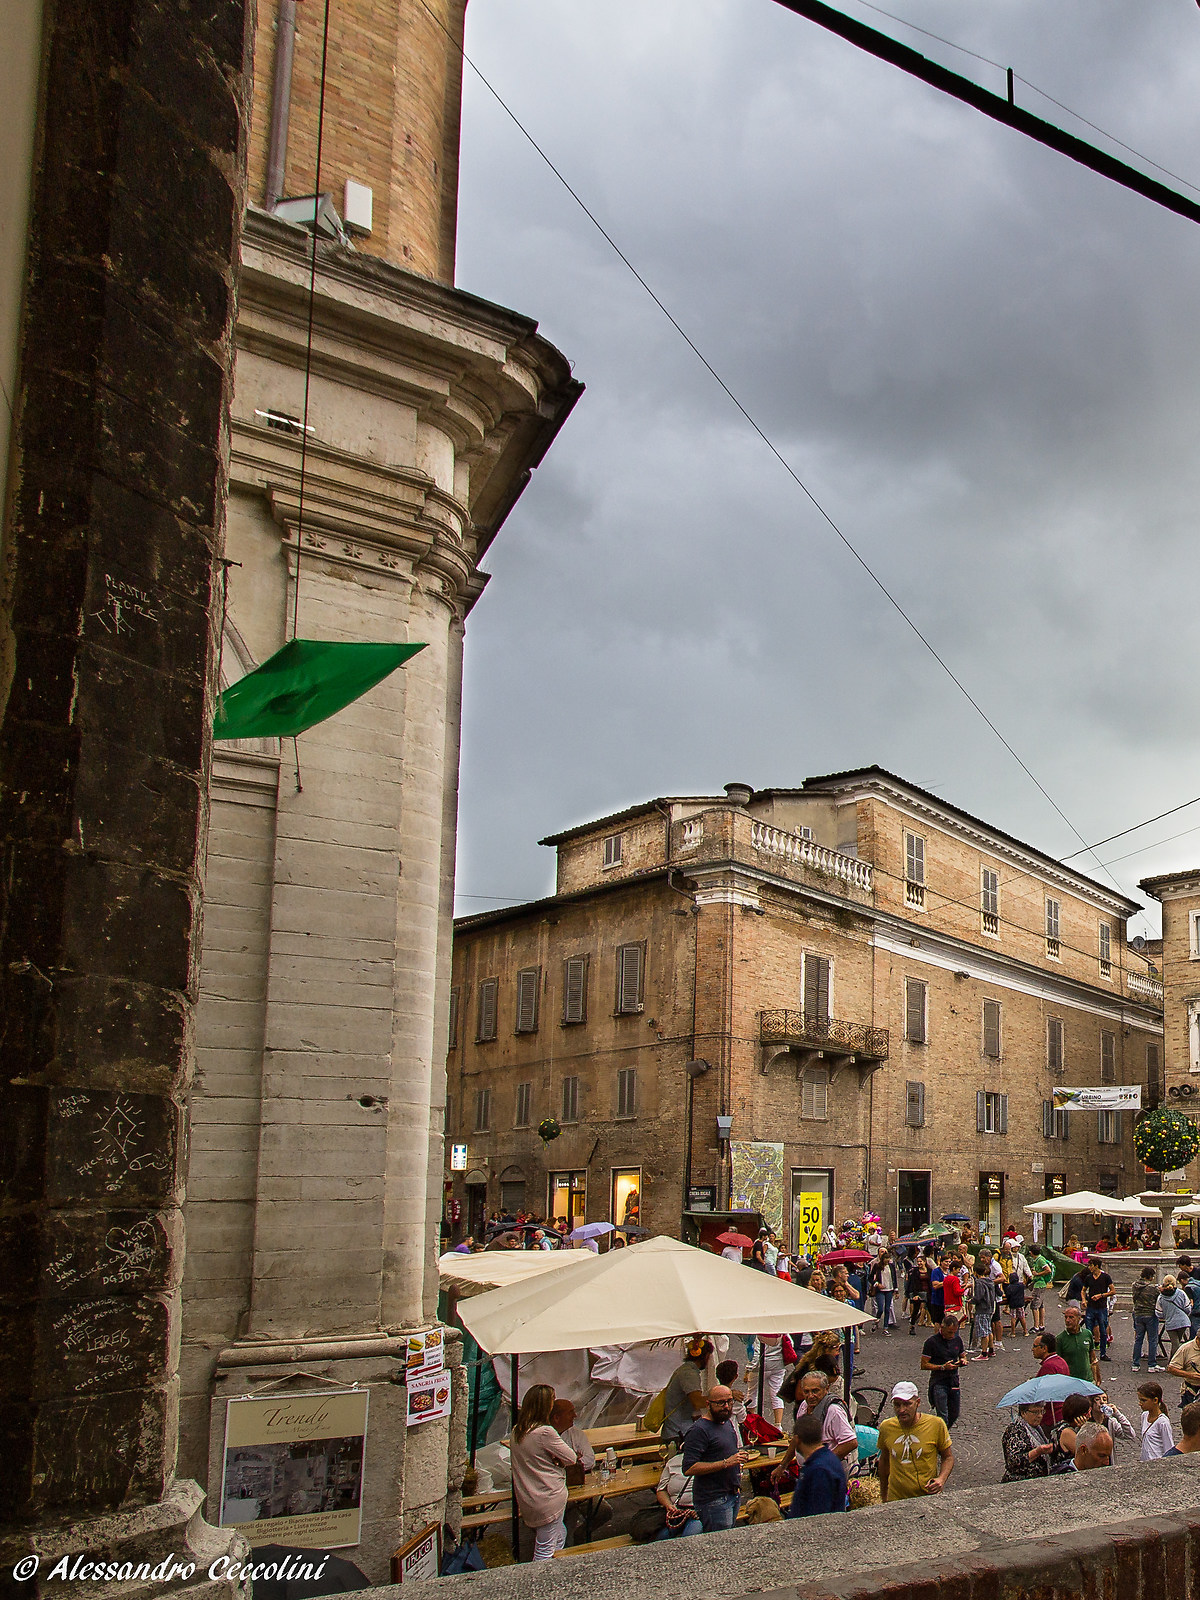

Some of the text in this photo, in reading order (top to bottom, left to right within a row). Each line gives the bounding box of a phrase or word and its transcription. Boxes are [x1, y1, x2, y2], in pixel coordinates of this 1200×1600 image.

[802, 1206, 820, 1224] 50
[803, 1225, 818, 1244] %
[262, 1396, 336, 1439] Trendy
[256, 1525, 289, 1535] Bigiotteria
[263, 1521, 284, 1529] regalo
[288, 1516, 320, 1524] Biancheria
[294, 1528, 308, 1536] ogni
[308, 1525, 338, 1533] occasione
